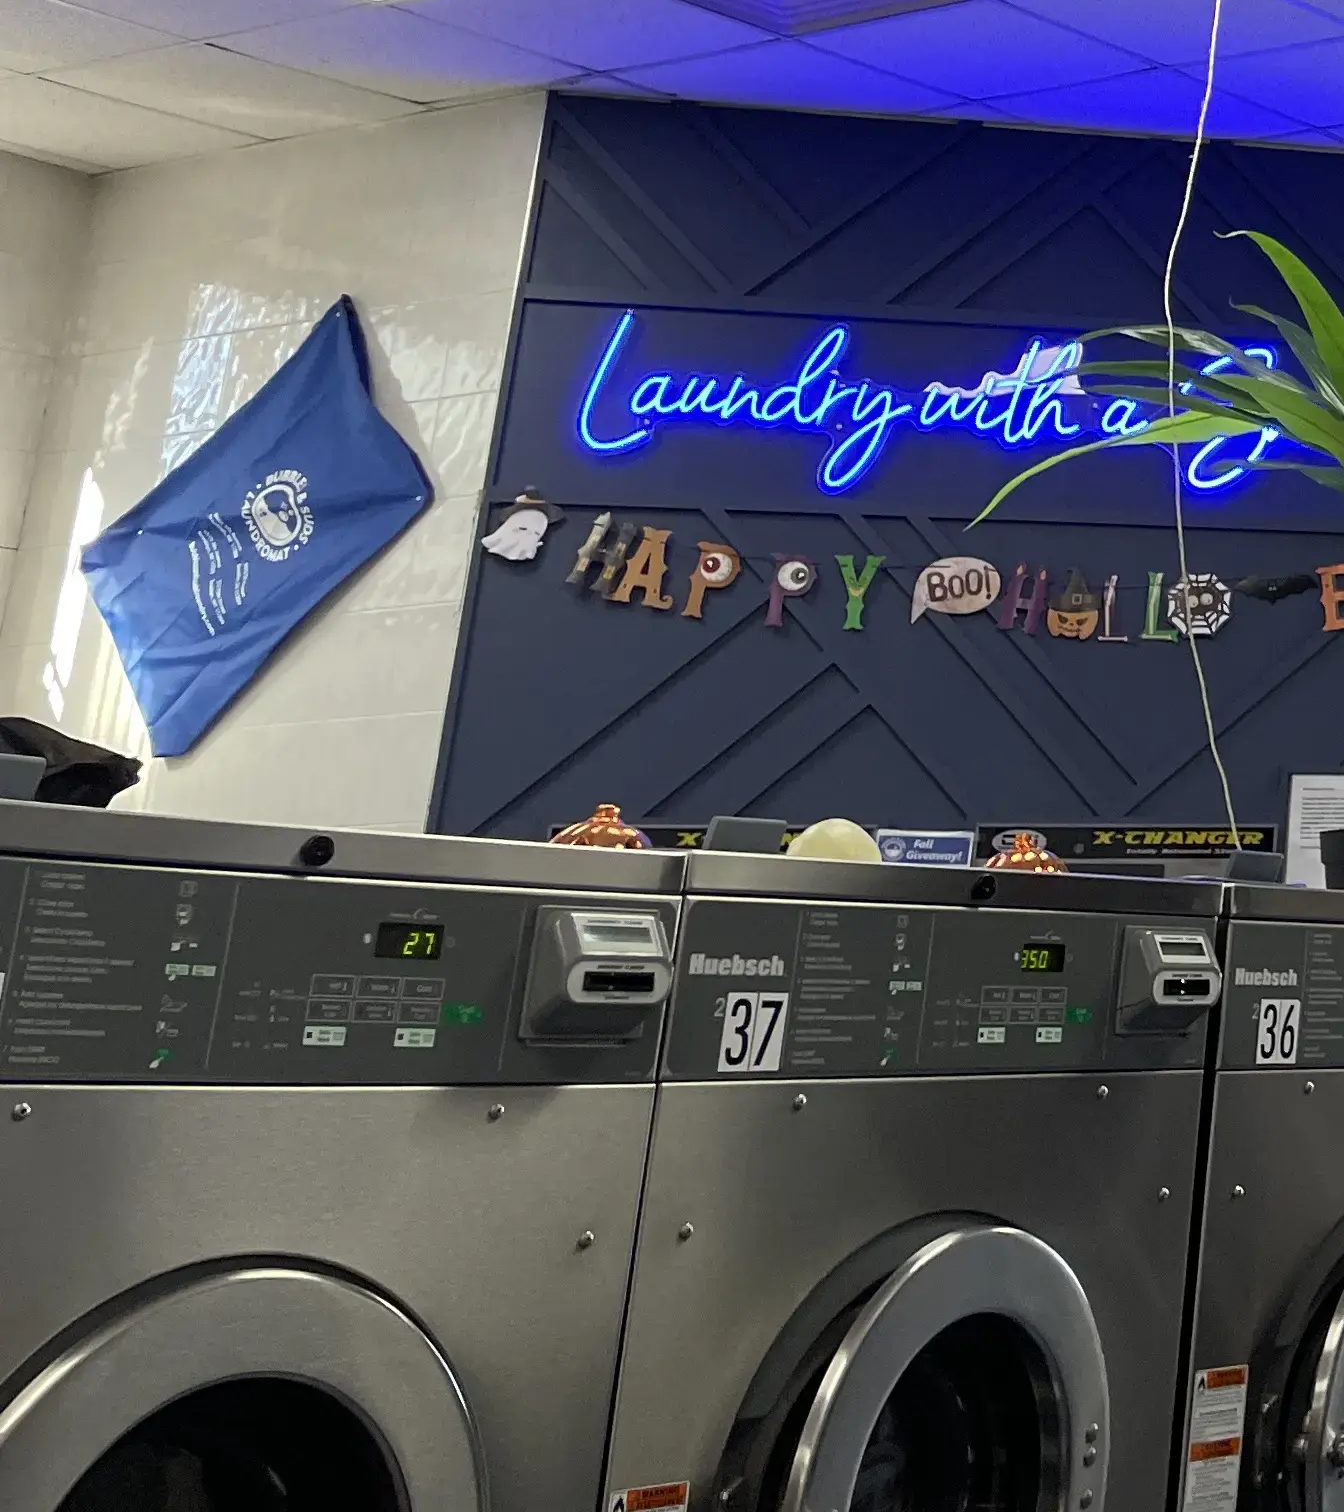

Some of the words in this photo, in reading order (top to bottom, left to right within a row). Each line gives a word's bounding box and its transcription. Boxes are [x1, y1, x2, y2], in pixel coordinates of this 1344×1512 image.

[577, 308, 911, 496] Laundry
[920, 340, 1080, 444] with
[1101, 398, 1149, 435] a
[565, 511, 886, 631] HAPPY
[926, 566, 996, 604] BOO!
[913, 839, 935, 849] Fall
[1093, 831, 1264, 845] X-CHANGER
[402, 933, 434, 955] 27
[689, 953, 784, 976] Huebsch
[1235, 968, 1298, 986] Huebsch
[725, 999, 784, 1066] 37
[1260, 1004, 1295, 1059] 36
